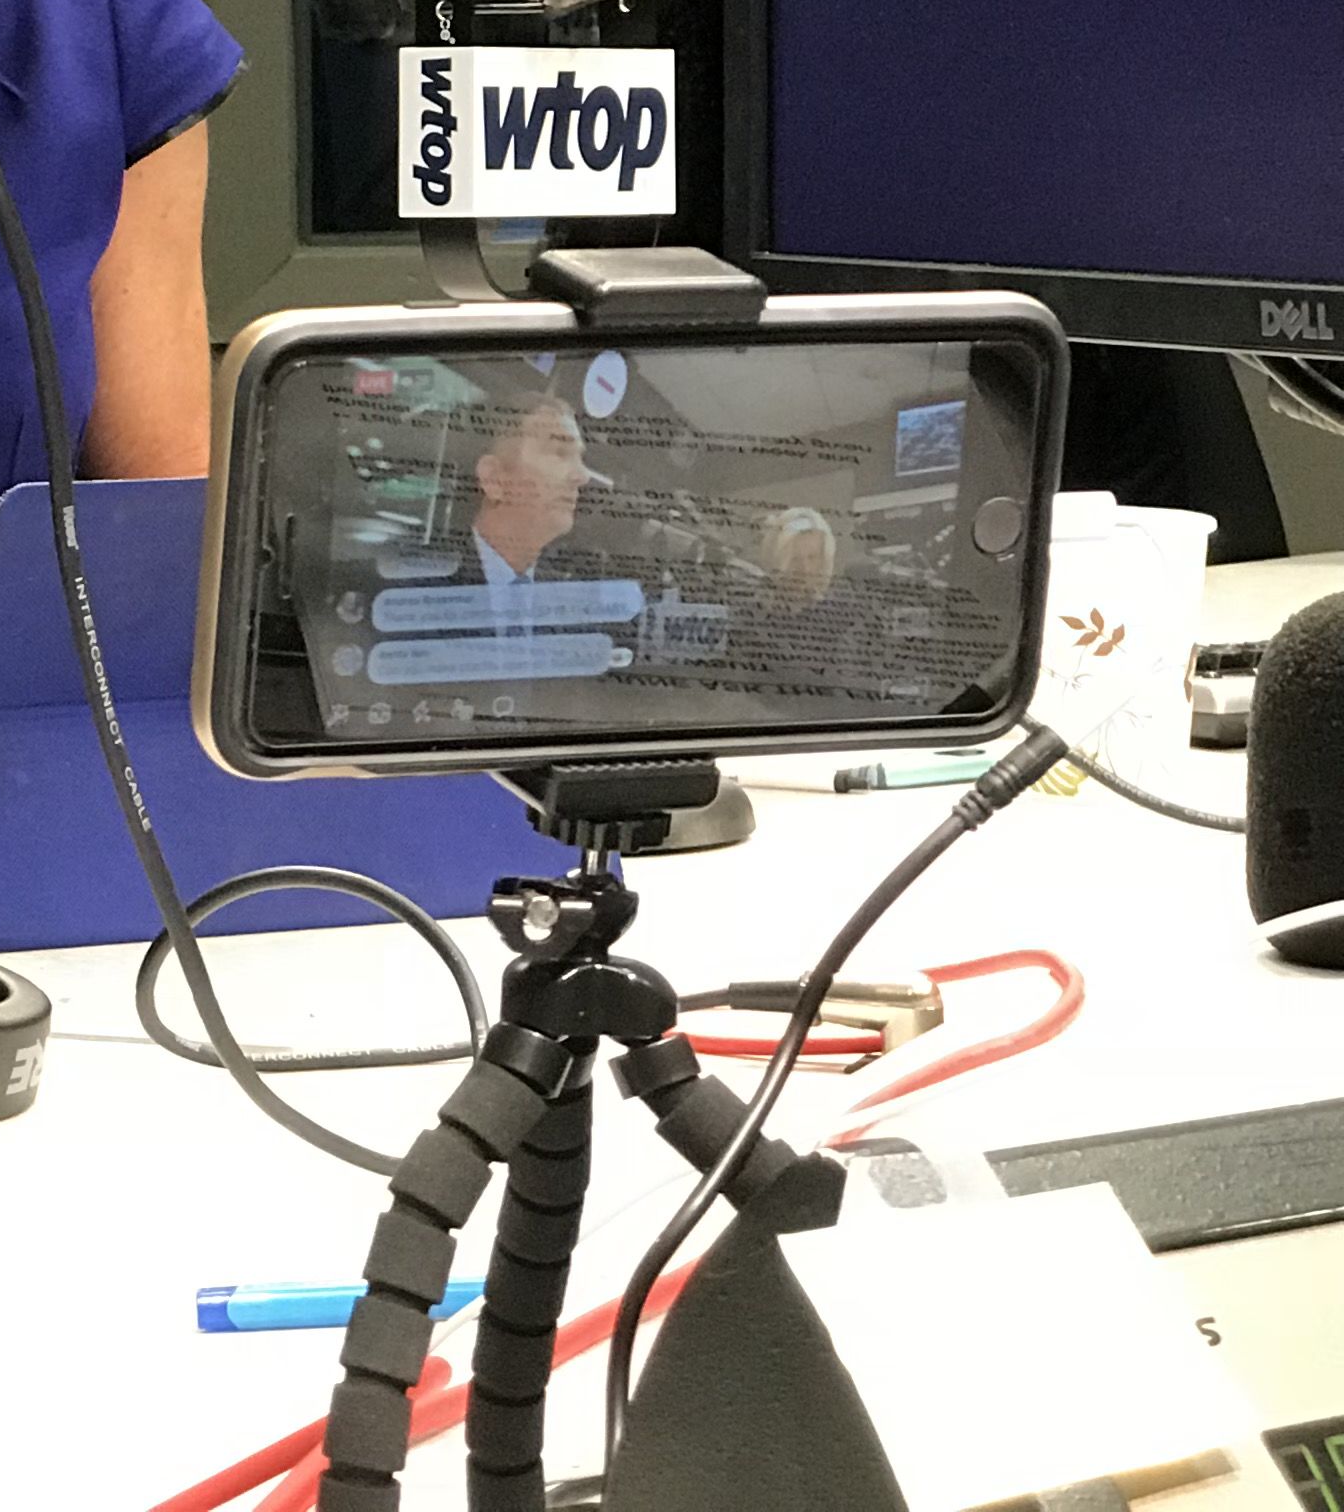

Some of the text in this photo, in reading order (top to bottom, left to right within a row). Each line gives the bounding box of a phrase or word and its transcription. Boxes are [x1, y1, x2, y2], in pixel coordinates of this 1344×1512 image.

[413, 57, 667, 206] wtop wtop
[1260, 299, 1334, 341] DELL
[74, 576, 153, 833] INTERCONNECT CABLE
